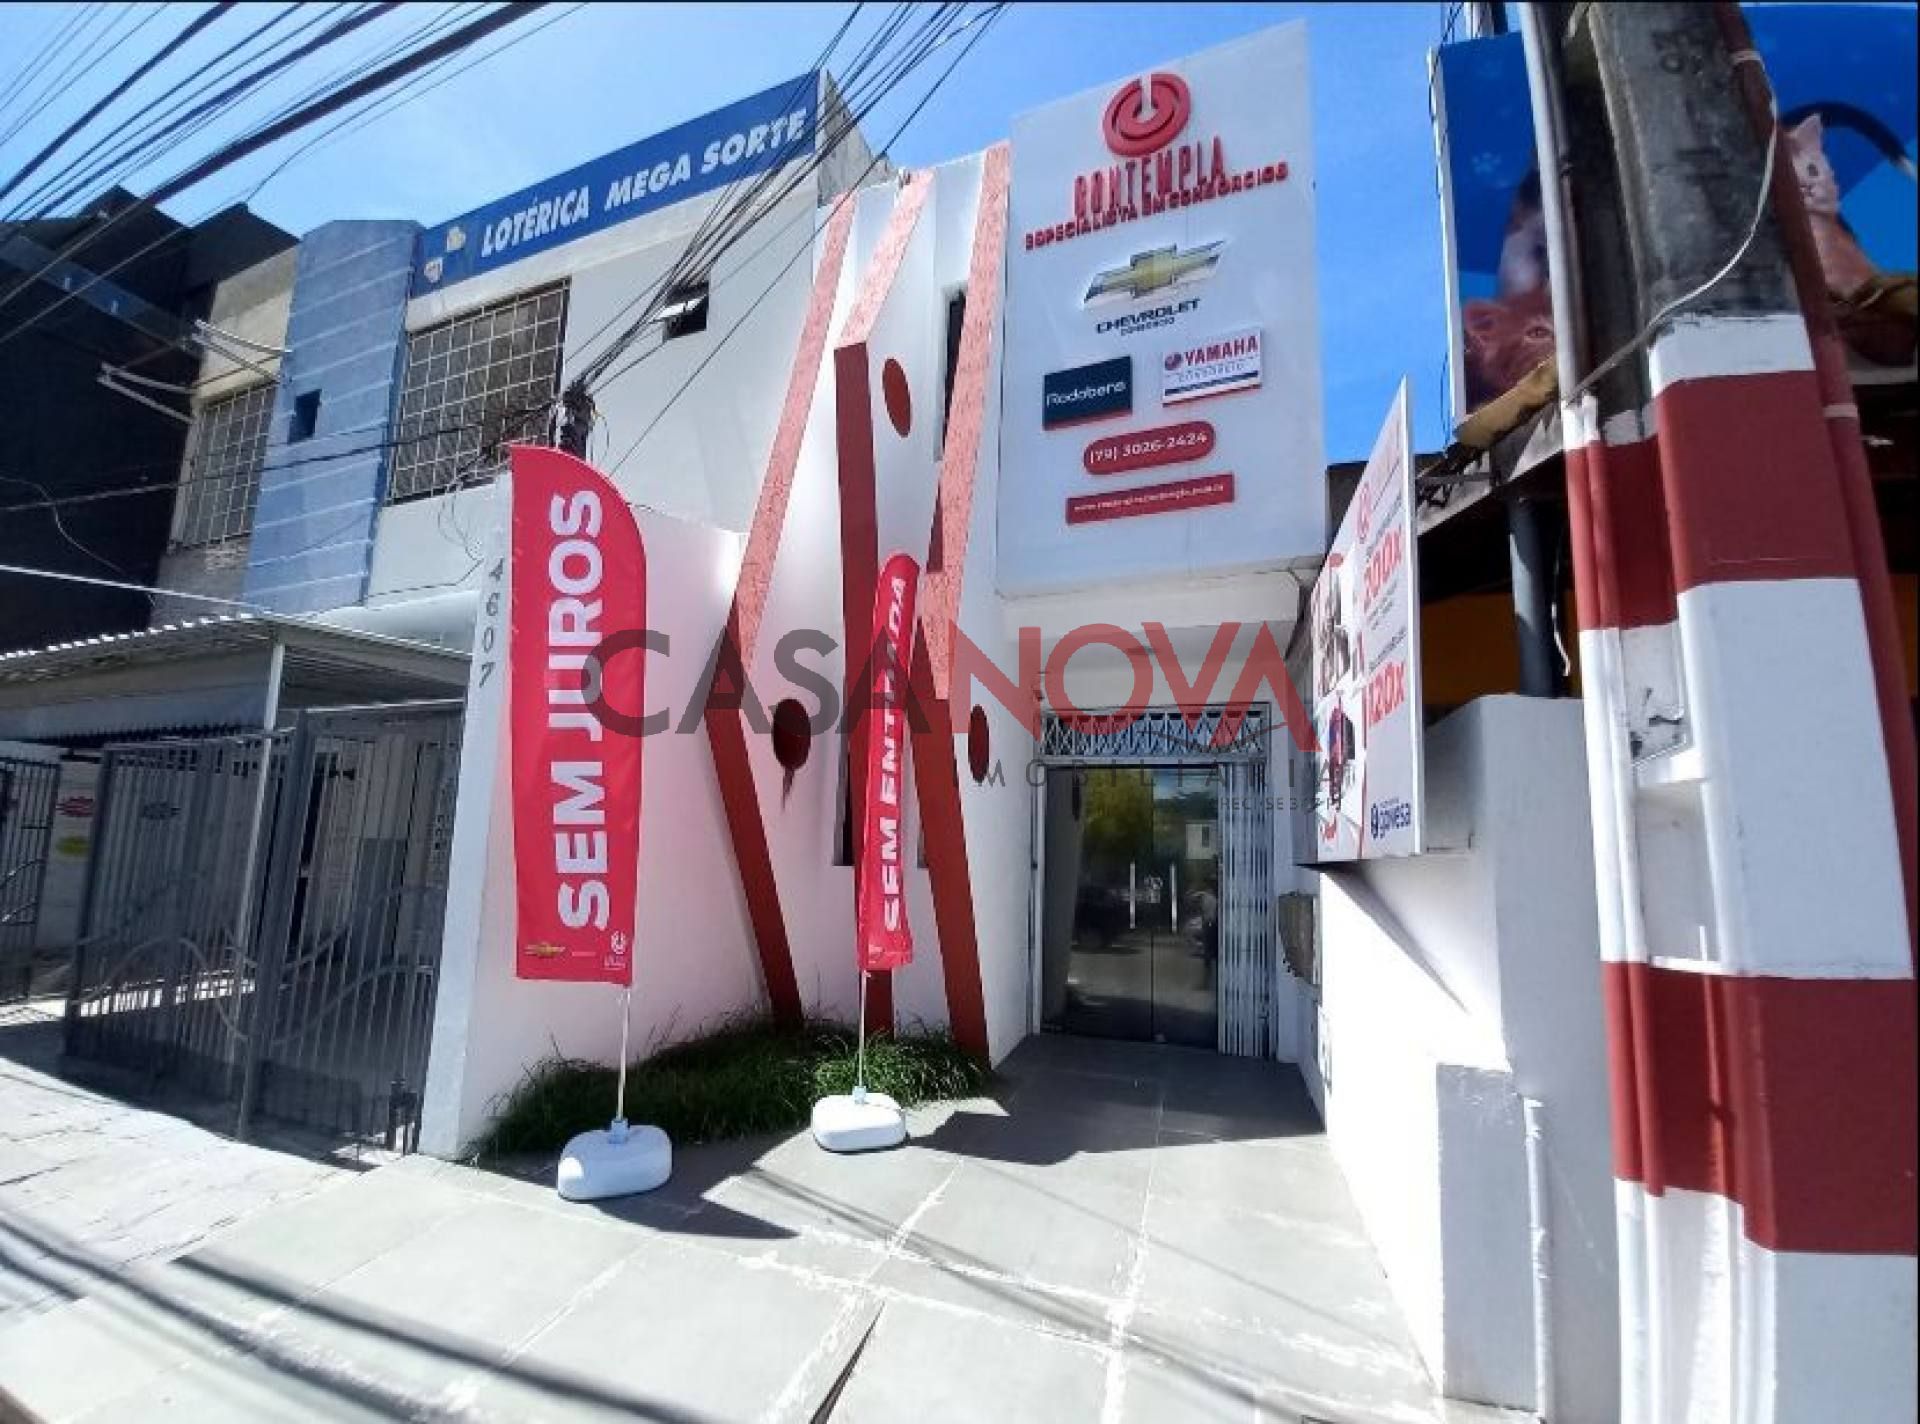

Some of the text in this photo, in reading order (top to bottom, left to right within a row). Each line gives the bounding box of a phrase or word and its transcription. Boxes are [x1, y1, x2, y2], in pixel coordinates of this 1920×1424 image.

[481, 108, 806, 258] LOTÉRICA MEGA SORTE
[1096, 299, 1200, 334] CHEVROLET
[1184, 335, 1258, 366] YAMAHA
[1046, 380, 1127, 408] Rodobens
[1122, 432, 1207, 457] 3026-2424
[479, 557, 505, 688] 4607
[547, 489, 610, 929] SEM JUROS
[879, 815, 901, 932] SEM
